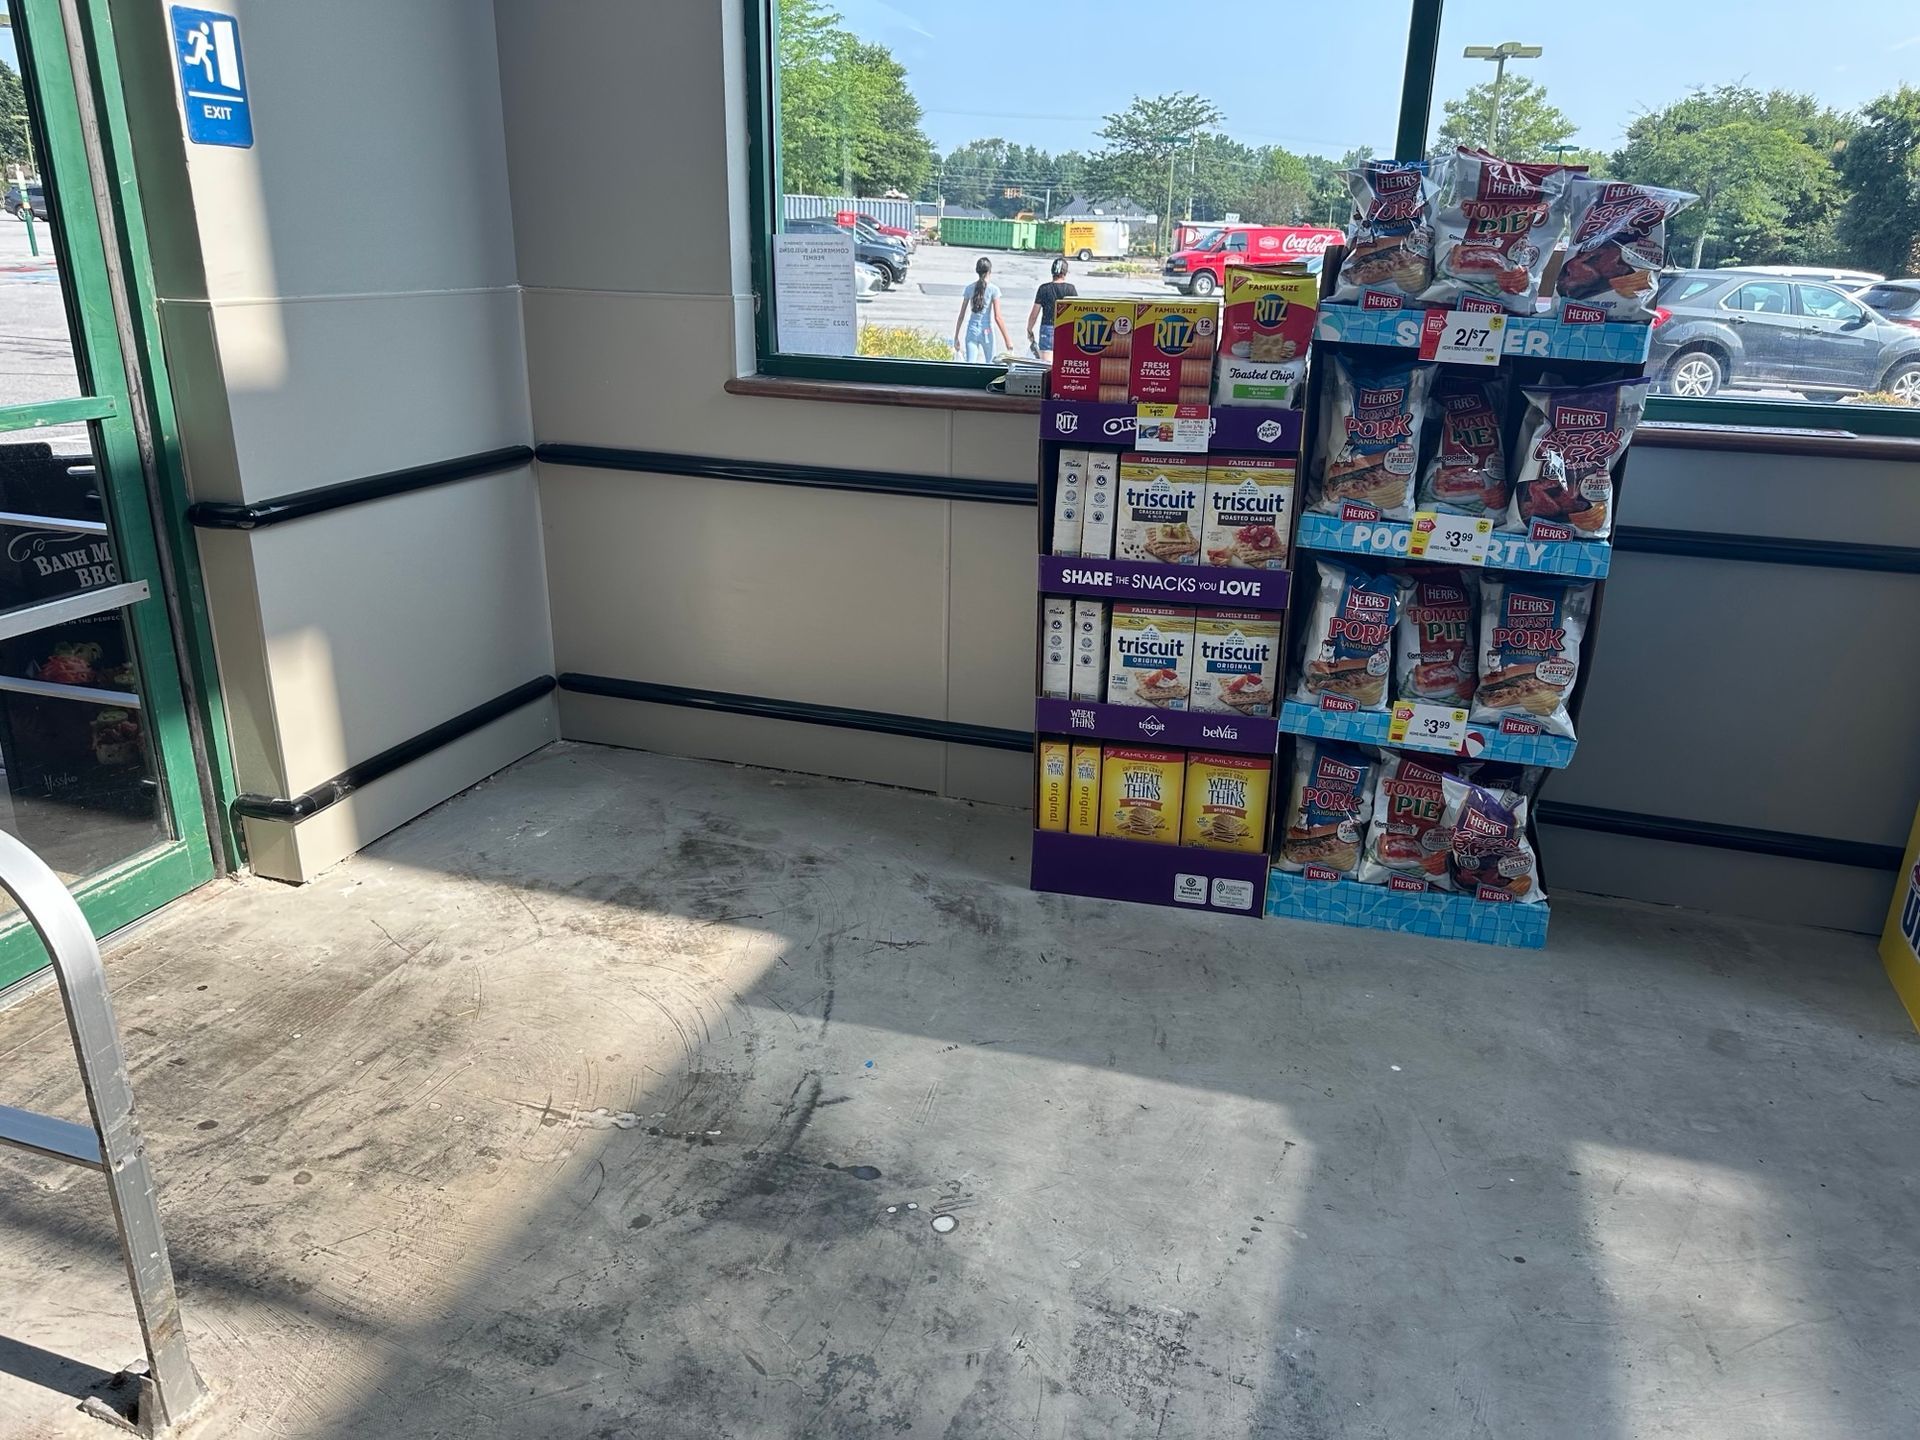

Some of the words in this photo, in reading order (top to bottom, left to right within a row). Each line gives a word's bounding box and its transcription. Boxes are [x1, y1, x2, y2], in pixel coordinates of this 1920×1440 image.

[203, 105, 232, 120] EXIT
[1381, 174, 1418, 190] HERR'S
[1493, 182, 1531, 198] HERR'S
[1610, 186, 1642, 198] HERR
[1479, 212, 1530, 233] PIE
[1248, 284, 1279, 292] FAMILY
[1368, 295, 1399, 308] HERR'S
[1466, 303, 1498, 313] HERR'S
[1073, 305, 1100, 313] FAMILY
[1253, 297, 1289, 322] RITZ
[1568, 308, 1601, 321] HERR'S
[1118, 318, 1128, 327] 12
[1200, 320, 1210, 328] 12
[1073, 316, 1114, 347] RITZ
[1153, 318, 1195, 348] RITZ
[1454, 328, 1490, 347] 2/$7
[1063, 359, 1089, 368] FRESH
[1142, 361, 1169, 369] FRESH
[1060, 367, 1091, 375] STACKS
[1140, 369, 1171, 377] STACKS
[1229, 367, 1268, 380] Toasted
[1270, 369, 1295, 382] Chips
[1364, 391, 1399, 404] HERR'S
[1447, 398, 1476, 410] ERR'S
[1056, 412, 1078, 430] RITZ
[1344, 413, 1413, 439] PORK
[1561, 413, 1601, 426] HERR'S
[1451, 427, 1495, 448] PIE
[1126, 488, 1196, 509] triscuit
[1213, 491, 1285, 513] triscuit
[1346, 508, 1376, 520] HERR'S
[1536, 527, 1568, 539] HERR'S
[33, 549, 90, 577] BANH
[89, 541, 112, 563] M
[1061, 568, 1113, 586] SHARE
[1115, 576, 1130, 585] THE
[1131, 574, 1197, 593] SNACKS
[1198, 581, 1217, 591] YOU
[1219, 580, 1261, 597] LOVE
[1352, 593, 1386, 608] HERR'S
[1428, 589, 1459, 600] HERR'S
[1513, 599, 1550, 612] HERR'S
[79, 617, 92, 625] THE
[93, 615, 121, 624] PERFEC
[1346, 609, 1389, 624] ROAST
[1406, 606, 1473, 625] TOMAT
[1507, 616, 1554, 629] ROAST
[1328, 616, 1394, 646] PORK
[1426, 621, 1466, 642] PIE
[1118, 636, 1184, 656] triscuit
[1492, 627, 1566, 651] PORK
[1201, 641, 1270, 661] triscuit
[1341, 641, 1377, 652] SANDWIC
[1504, 648, 1549, 657] SANDWICH
[1132, 657, 1168, 665] ORIGINAL
[1216, 662, 1252, 670] ORIGINAL
[1325, 699, 1354, 710] HERR'S
[1070, 709, 1095, 719] WHEAT
[1070, 717, 1095, 730] THINS
[1138, 721, 1165, 731] triscuit
[1506, 722, 1536, 734] HERR'S
[1202, 724, 1238, 740] belVita
[1204, 757, 1233, 765] FAMILY
[1047, 768, 1064, 776] THINS
[1078, 772, 1096, 780] THINS
[1124, 771, 1162, 786] WHEAT
[1323, 763, 1356, 780] HERR'S
[1408, 767, 1441, 782] HERR'S
[1208, 778, 1247, 792] WHEAT
[1316, 779, 1356, 794] ROAST
[1382, 780, 1444, 801] TOMAT
[1124, 784, 1161, 801] THINS
[1208, 789, 1246, 808] THINS
[1049, 782, 1060, 822] original
[1079, 786, 1091, 826] original
[1302, 786, 1364, 814] PORK
[1395, 795, 1440, 821] PIE
[1470, 815, 1502, 835] HERR'S
[1309, 869, 1336, 880] HERR'S
[1394, 879, 1422, 890] HERR'S
[1482, 889, 1510, 901] HERR'S
